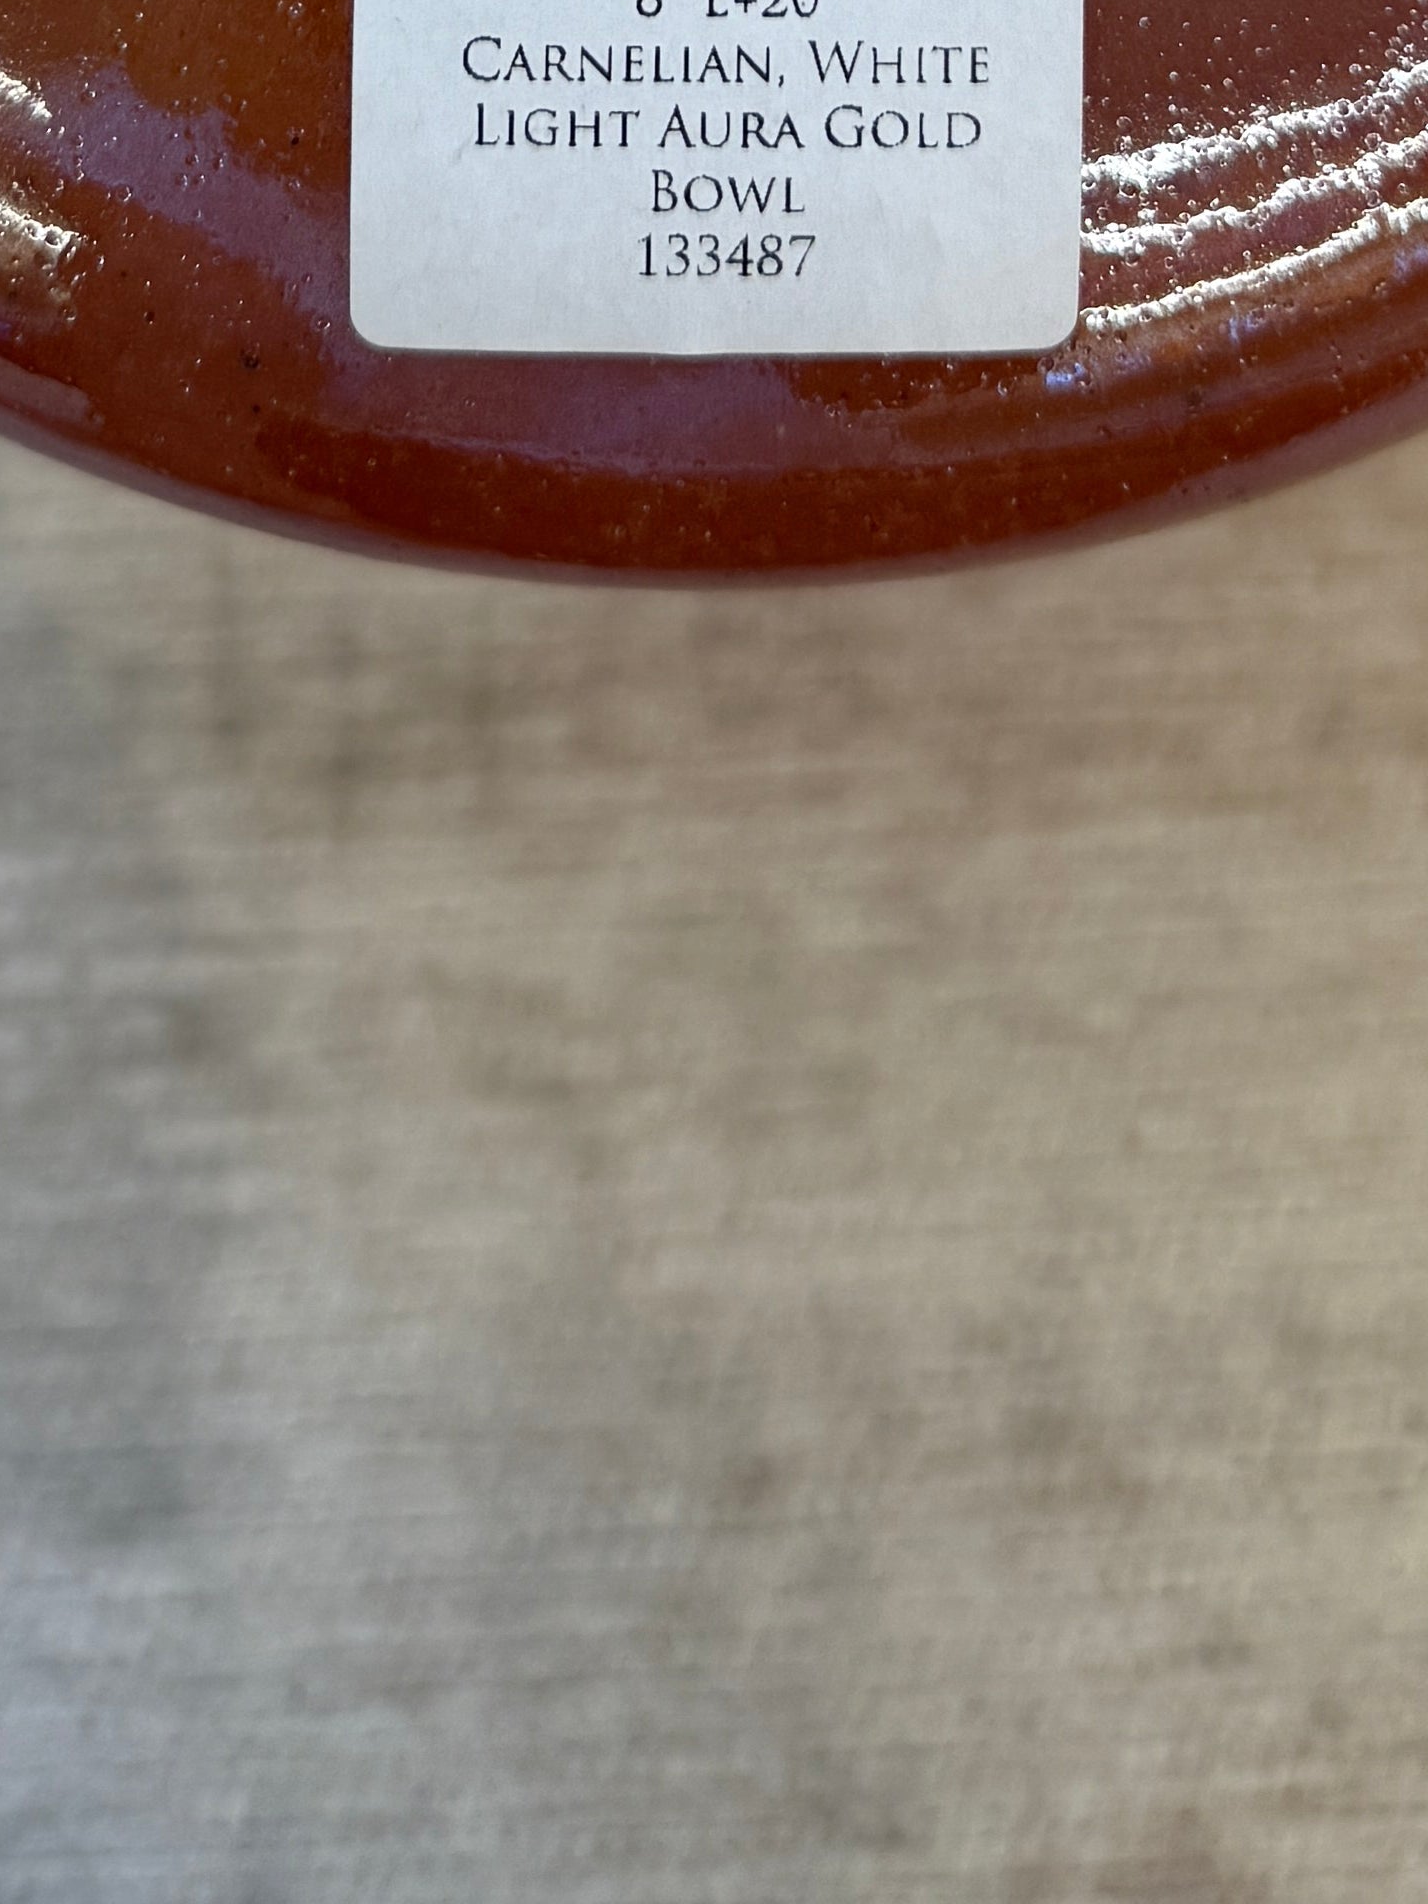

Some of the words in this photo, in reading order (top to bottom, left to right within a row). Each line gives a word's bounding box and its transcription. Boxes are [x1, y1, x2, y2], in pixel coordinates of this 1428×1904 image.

[461, 34, 787, 89] CARNELIAN,
[807, 39, 992, 85] WHITE
[472, 102, 642, 149] LIGHT
[656, 103, 806, 150] AURA
[824, 103, 984, 151] GOLD
[650, 168, 806, 215] BOWL
[636, 232, 818, 279] 133487
